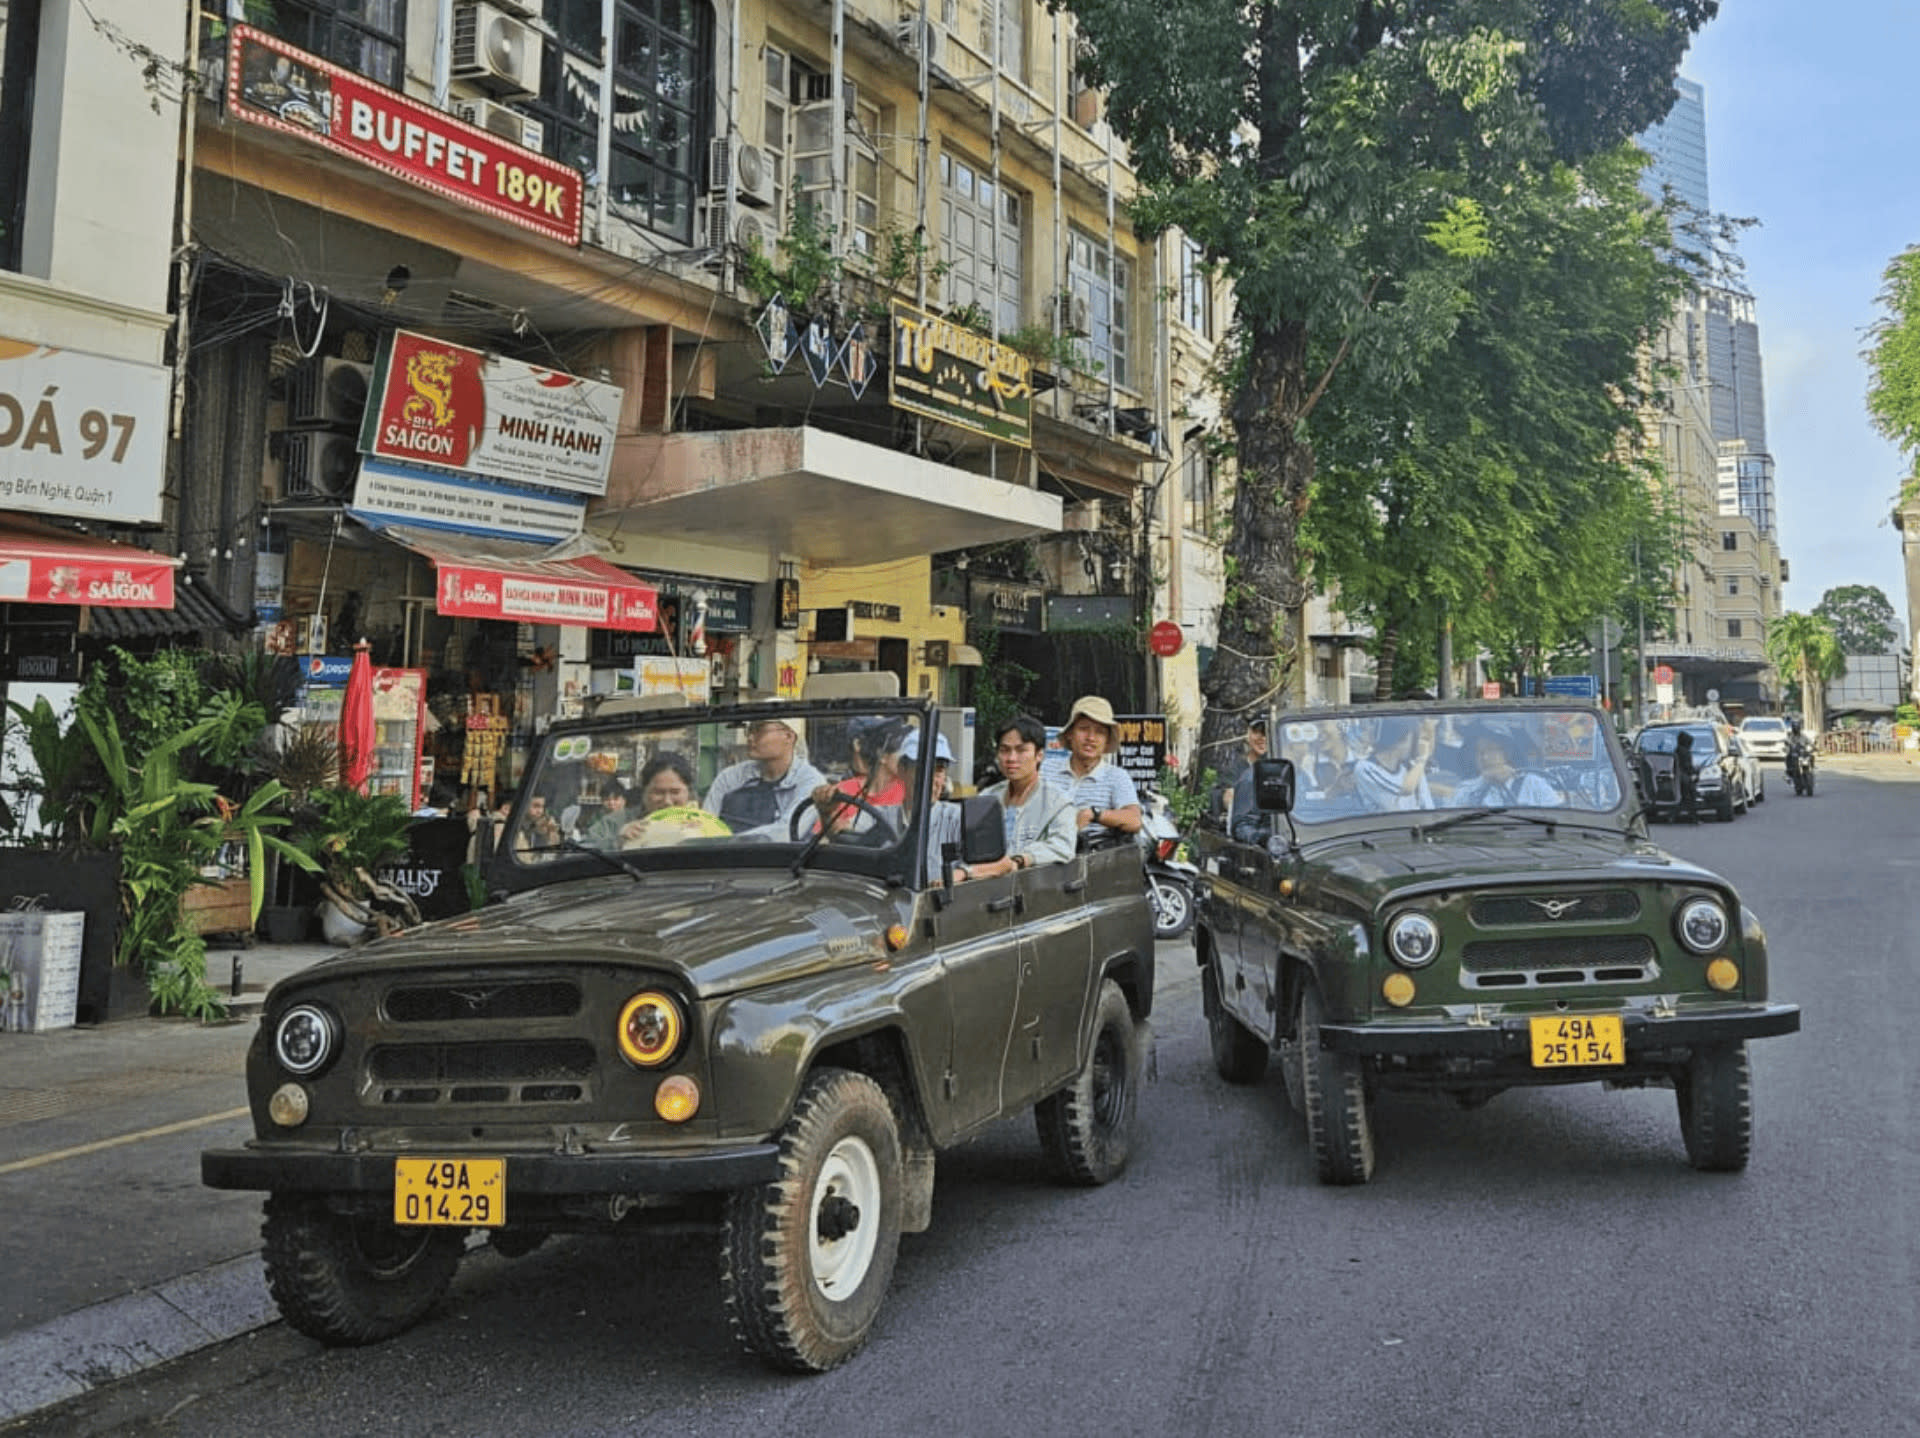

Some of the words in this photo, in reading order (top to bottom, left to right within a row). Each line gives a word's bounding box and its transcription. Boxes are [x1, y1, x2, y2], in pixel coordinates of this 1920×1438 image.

[350, 99, 487, 187] BUFFET
[494, 161, 565, 220] 189K
[79, 409, 136, 464] 97
[383, 425, 455, 456] SAIGON
[499, 415, 549, 445] MINH
[550, 425, 602, 457] HẠNH
[107, 491, 113, 505] 1
[88, 580, 156, 601] SAIGON
[463, 589, 497, 605] SAIGON
[1557, 1020, 1596, 1041] 49A
[1542, 1042, 1613, 1063] 251.54
[425, 1162, 470, 1190] 49A
[405, 1193, 490, 1221] 014.29
